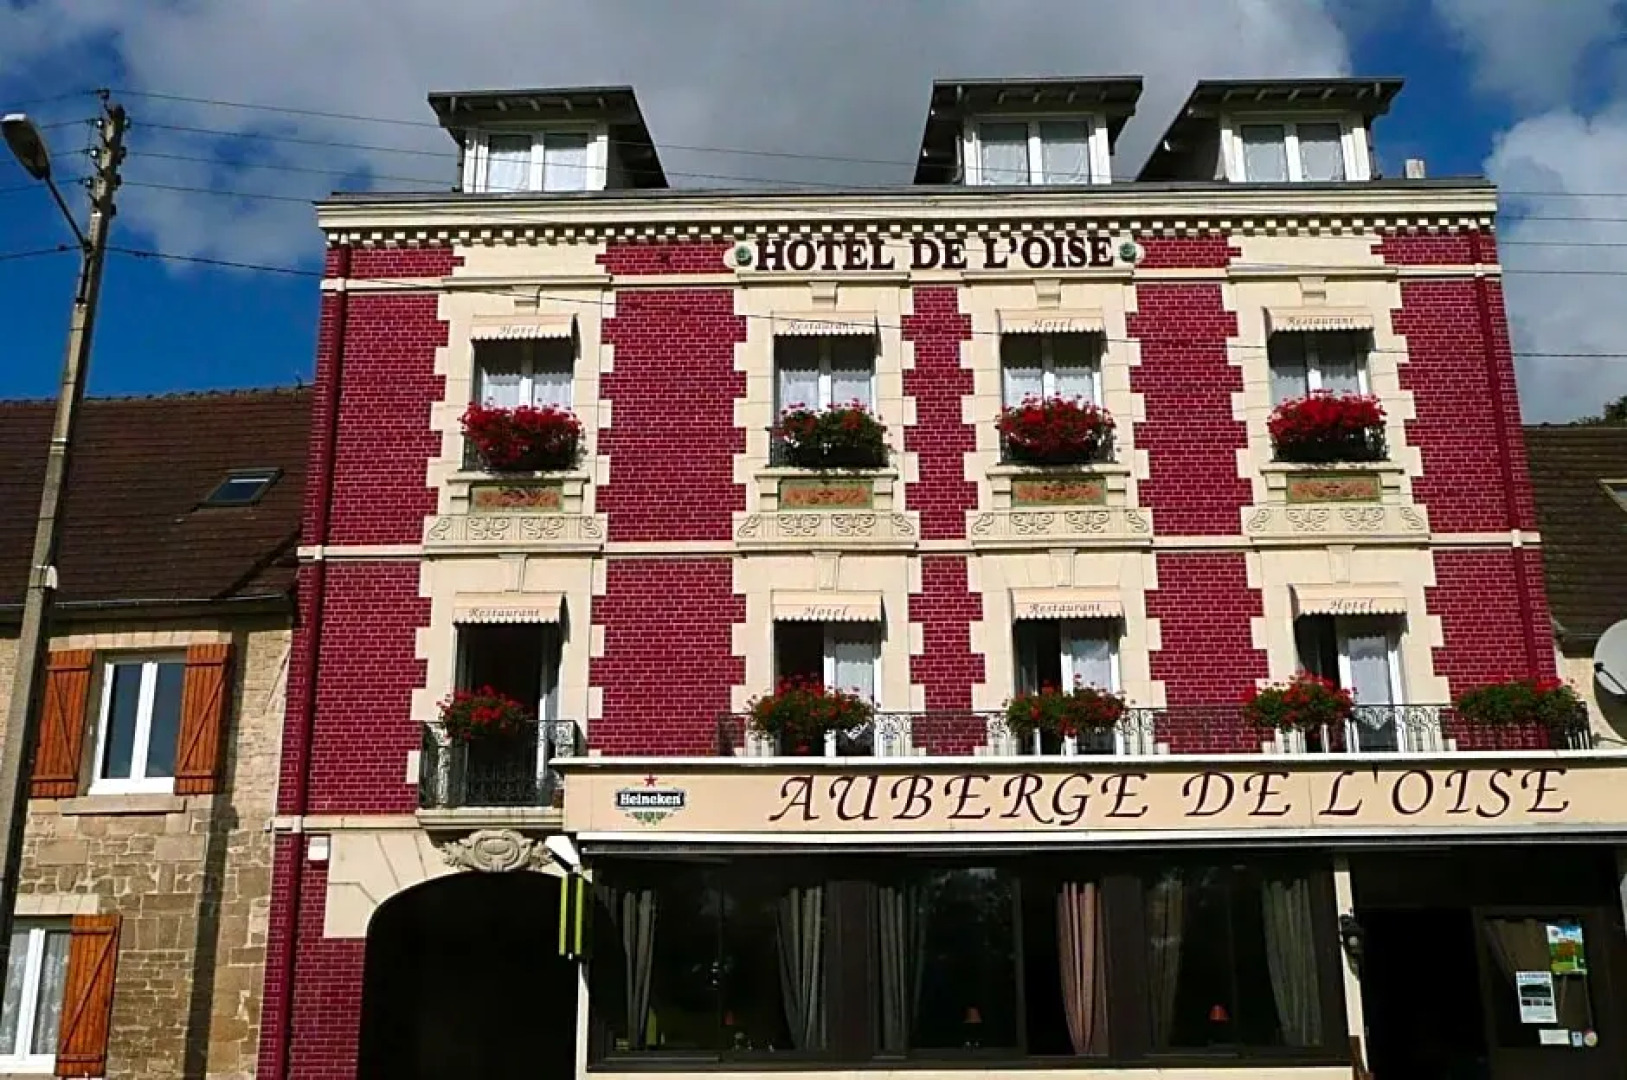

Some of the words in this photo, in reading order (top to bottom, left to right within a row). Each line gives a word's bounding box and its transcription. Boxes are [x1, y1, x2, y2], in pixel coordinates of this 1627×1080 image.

[755, 238, 895, 271] HOTEL
[909, 238, 968, 269] DE
[982, 236, 1115, 268] L'OISE
[803, 604, 850, 616] Hotel
[1029, 602, 1102, 613] Restaurant
[1329, 597, 1377, 610] Hotel
[468, 607, 541, 618] Restaurant
[619, 792, 682, 806] Heineken
[768, 772, 1150, 826] AUBERGE
[1181, 770, 1293, 817] DE
[1318, 767, 1571, 818] L'OISE
